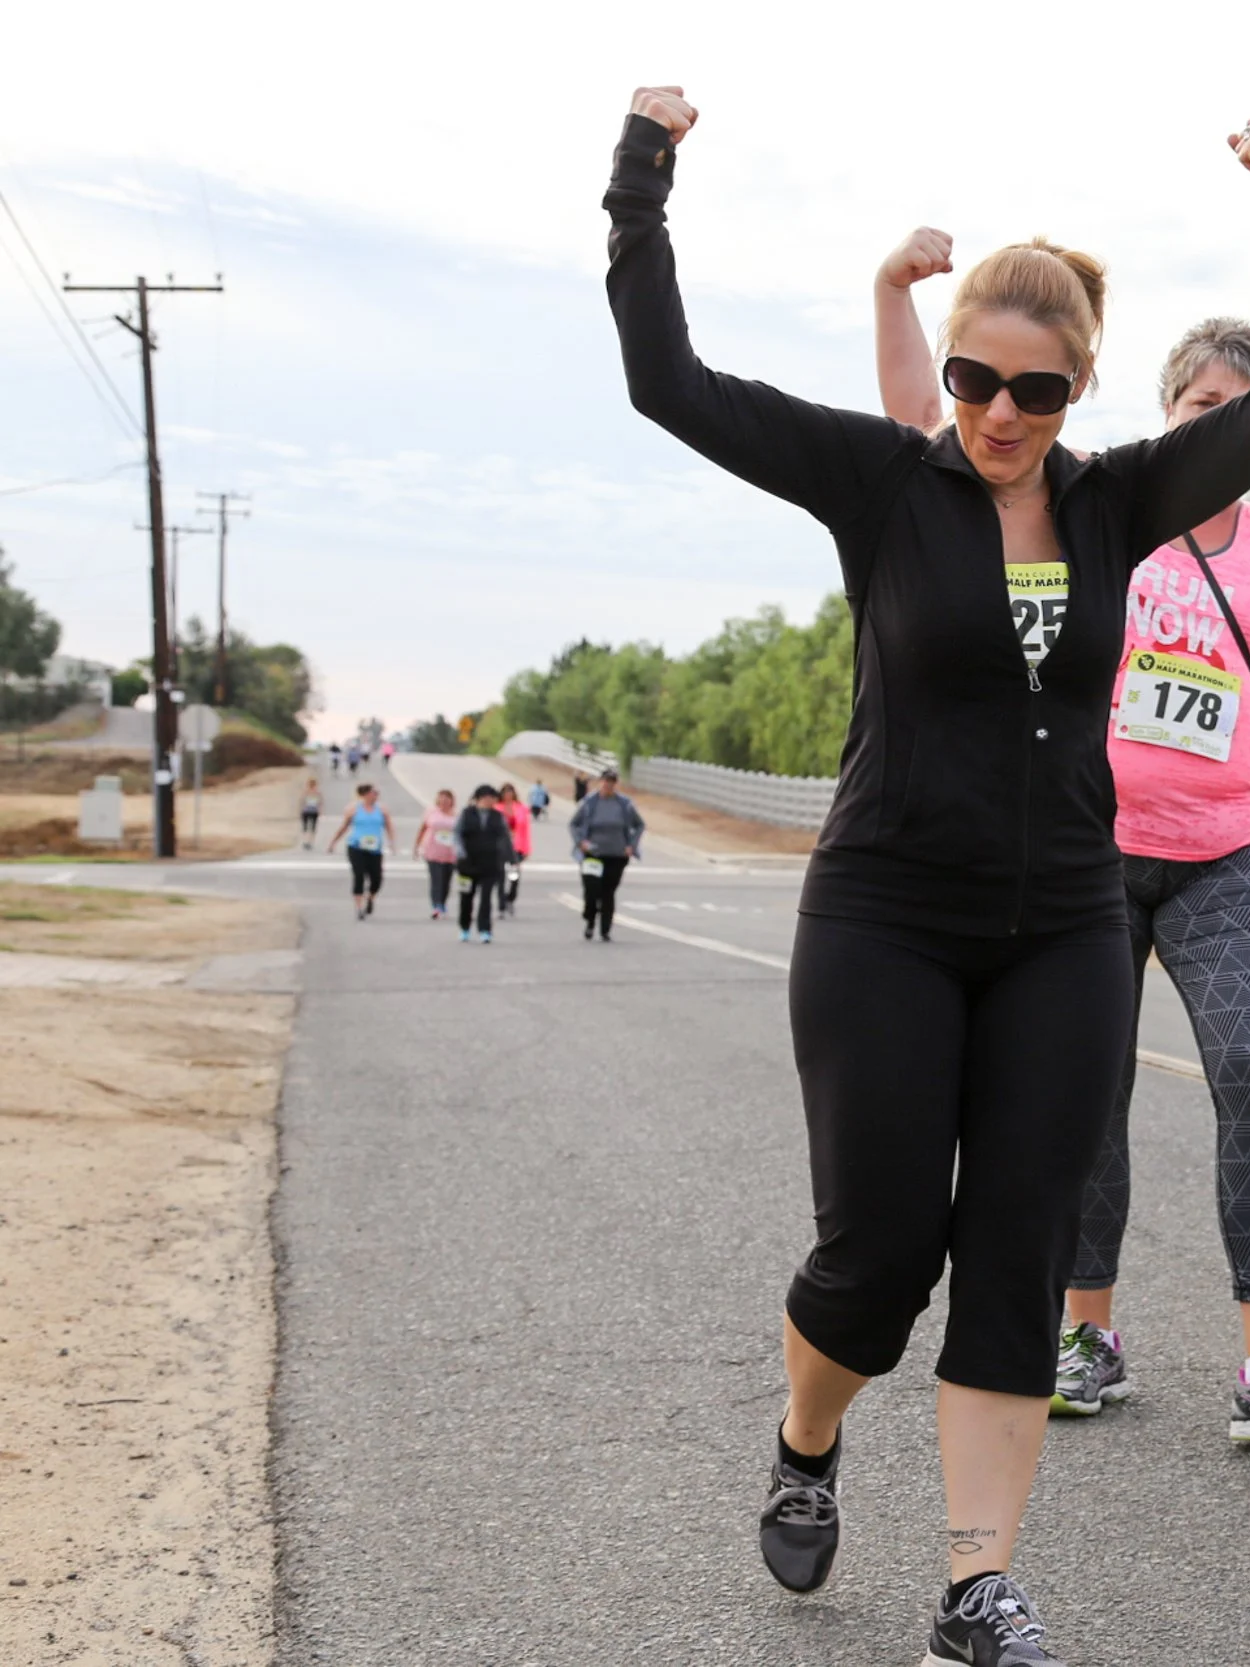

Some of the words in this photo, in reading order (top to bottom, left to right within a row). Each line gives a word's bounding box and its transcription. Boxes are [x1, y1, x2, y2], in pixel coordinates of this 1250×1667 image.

[1008, 578, 1031, 587] HALF
[1133, 560, 1235, 618] RUN
[1127, 591, 1226, 657] NOW
[1155, 664, 1177, 673] HALF
[1178, 669, 1224, 687] MARATHON
[1154, 681, 1222, 731] 178
